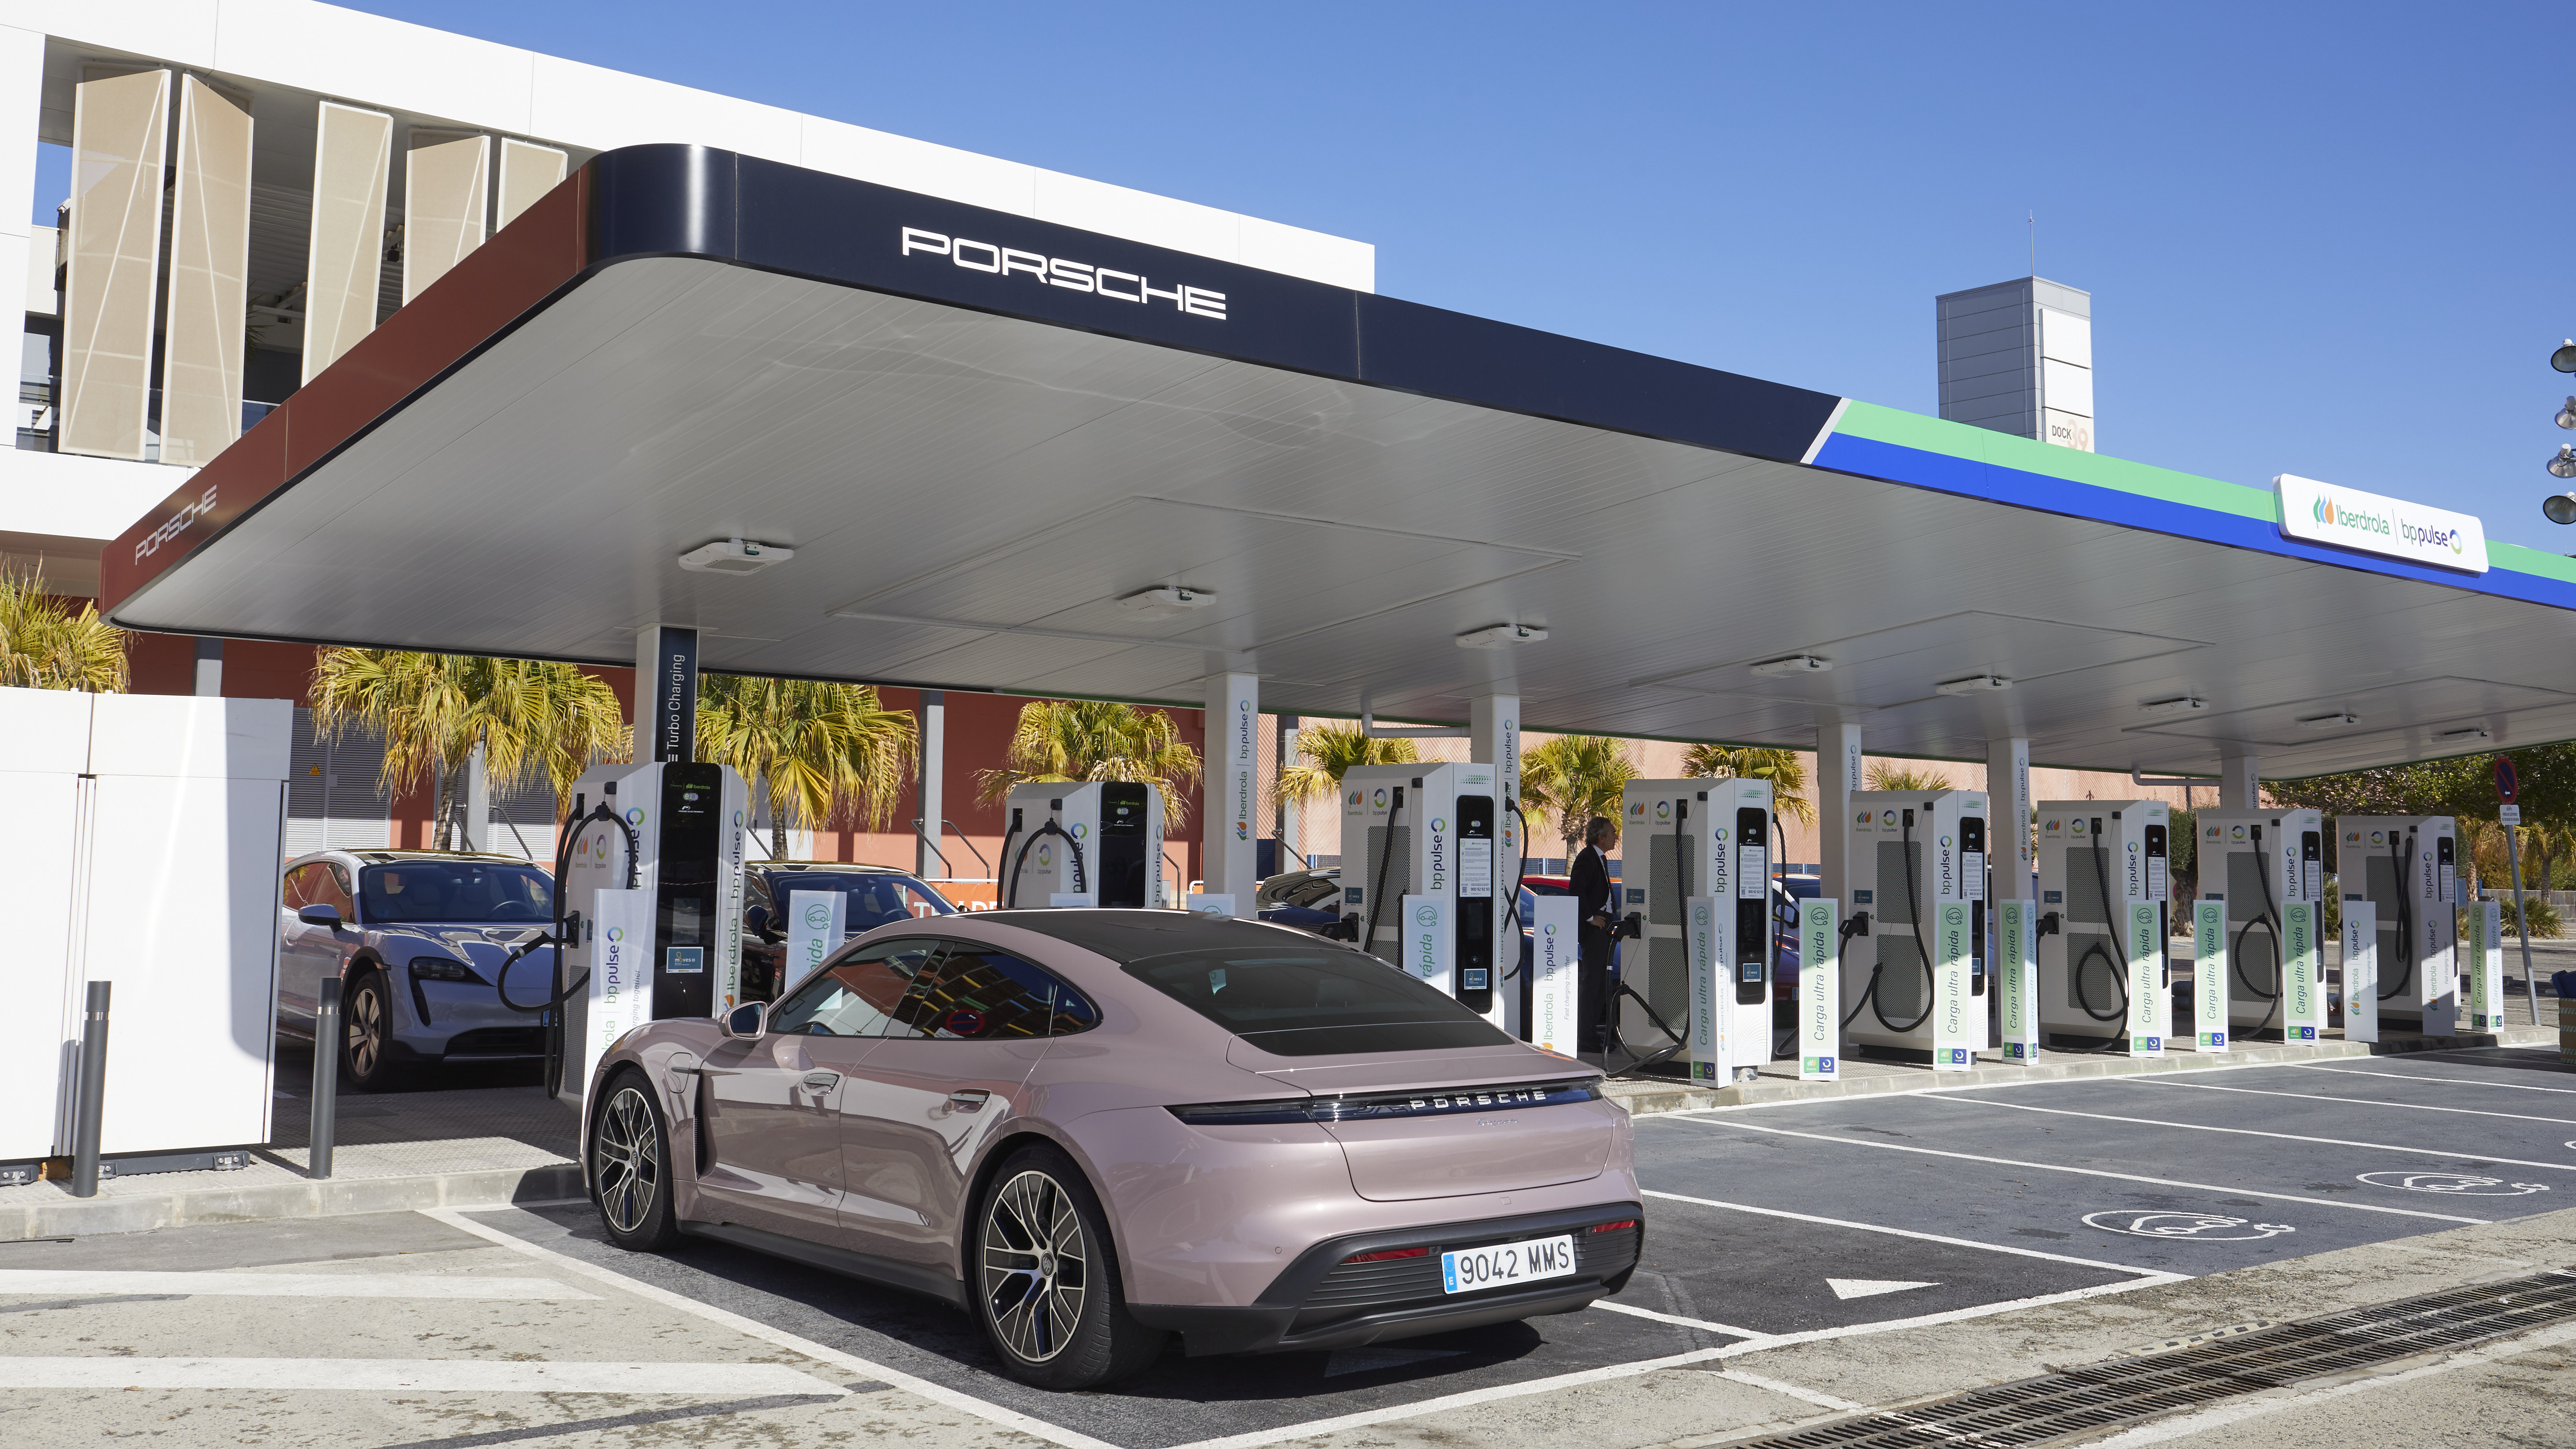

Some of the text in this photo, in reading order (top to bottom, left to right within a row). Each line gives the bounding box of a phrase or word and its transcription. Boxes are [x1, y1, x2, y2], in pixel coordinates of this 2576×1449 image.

[902, 226, 1227, 320] PORSCHE
[2052, 425, 2072, 440] DOCK
[135, 484, 217, 565] PORSCHE
[2336, 505, 2390, 535] Iberdrola
[668, 655, 685, 711] Charging
[667, 714, 680, 749] Turbo
[1239, 771, 1247, 819] Iberdrola
[727, 918, 737, 989] Iberdrola
[1419, 934, 1435, 978] rápida
[2008, 930, 2017, 964] rápida
[2293, 927, 2307, 1013] Carga ultra rápida
[633, 969, 641, 1002] together
[1697, 932, 1709, 1045] Carga ultra rápida
[1813, 932, 1827, 1040] Carga ultra rápida
[1947, 931, 1961, 1033] Carga ultra rápida
[2139, 929, 2153, 1023] Carga ultra rápida
[2205, 928, 2218, 1019] Carga ultra rápida
[1544, 993, 1553, 1039] Iberdrola
[2010, 996, 2018, 1028] Carga
[1410, 1091, 1546, 1110] PORSCHE
[1475, 1118, 1519, 1127] Taycan
[1449, 1276, 1454, 1286] E
[1460, 1242, 1569, 1284] 9042 MMS
